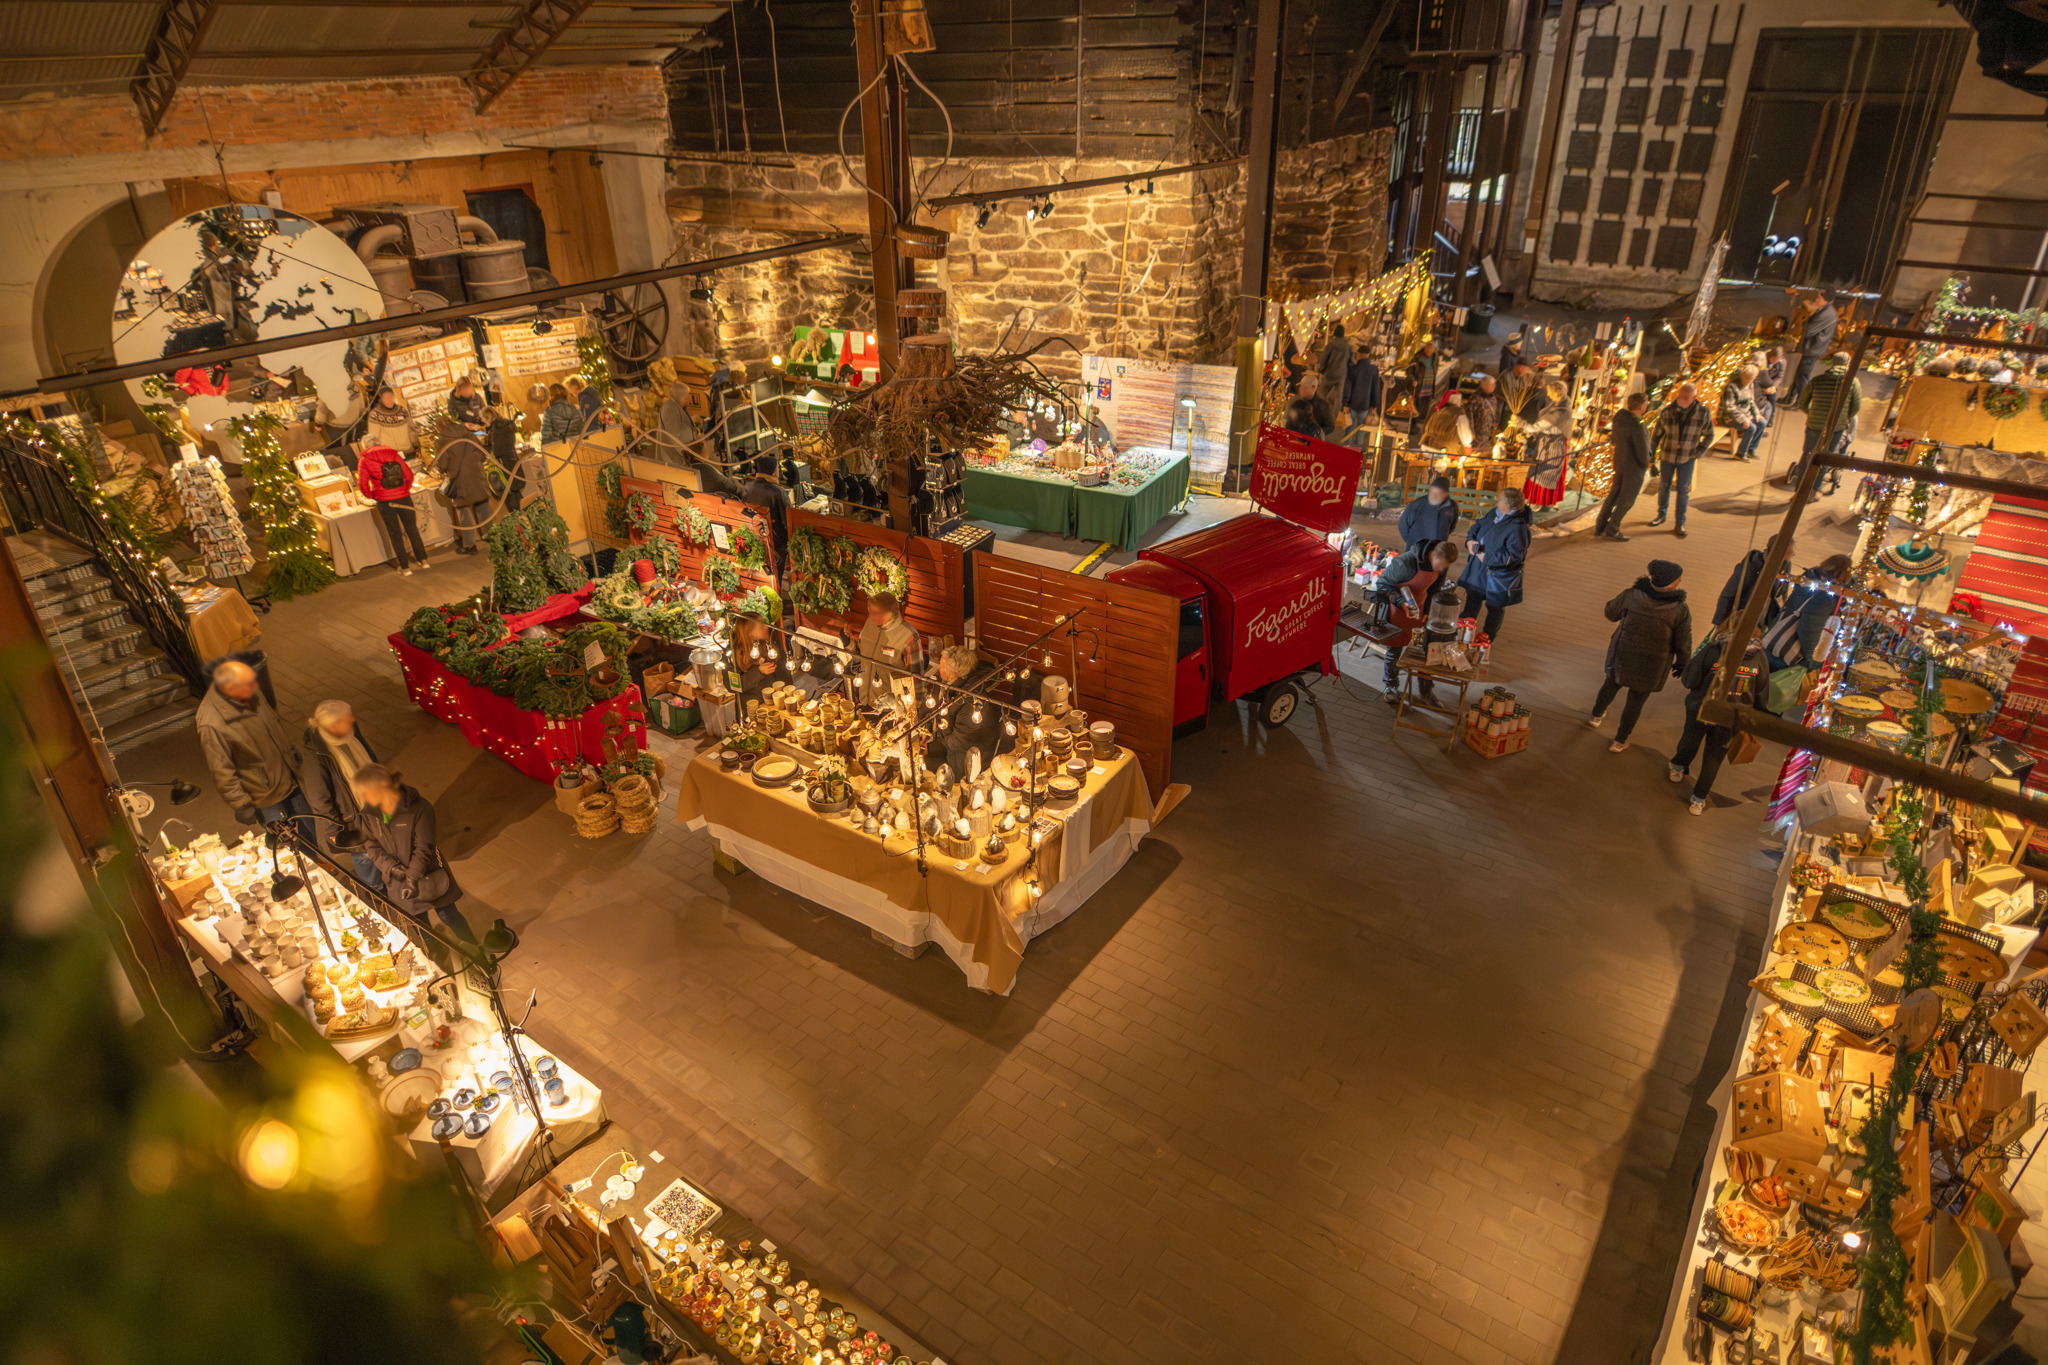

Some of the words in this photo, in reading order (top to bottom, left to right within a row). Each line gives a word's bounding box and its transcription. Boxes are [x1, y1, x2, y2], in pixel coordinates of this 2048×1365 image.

[1267, 460, 1287, 468] COFFEE
[1286, 452, 1315, 461] ANYWHERE
[1289, 461, 1306, 470] GREAT
[1262, 462, 1346, 506] Fogarolli
[1245, 577, 1327, 648] Fogarolli
[1284, 616, 1302, 631] GREAT
[1304, 601, 1323, 619] COFFEE
[1278, 621, 1307, 644] ANYWHERE
